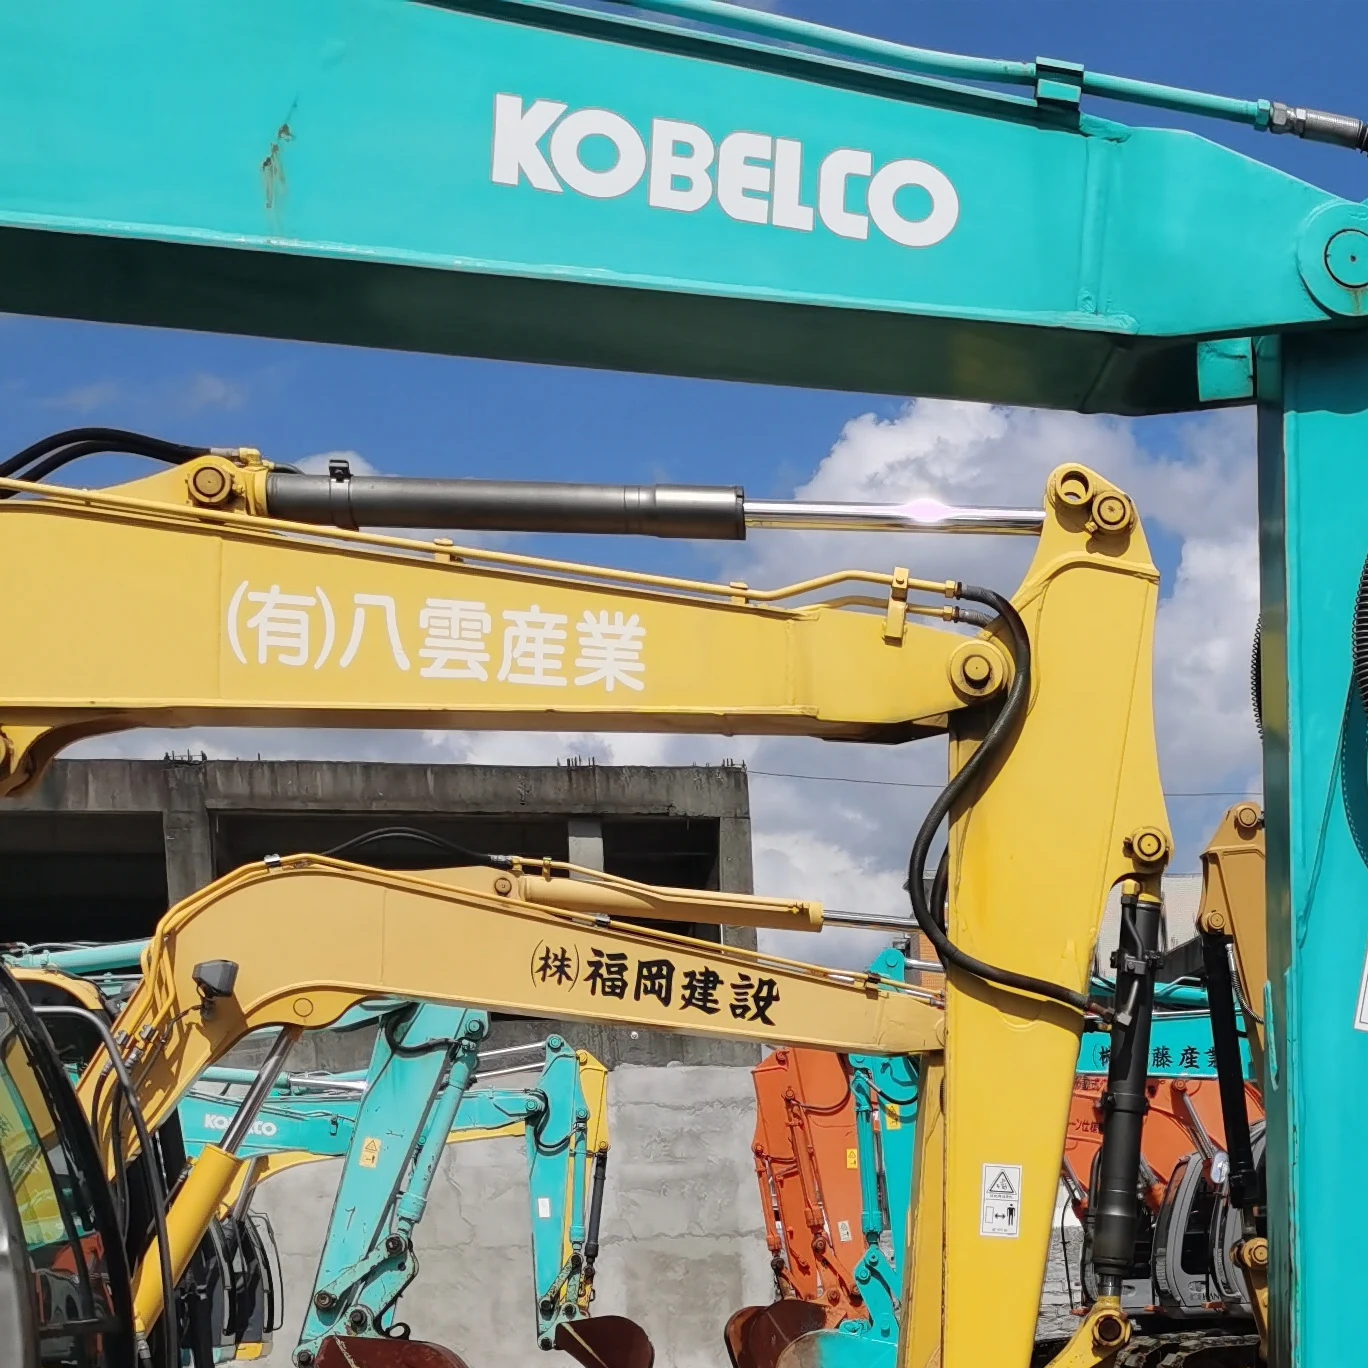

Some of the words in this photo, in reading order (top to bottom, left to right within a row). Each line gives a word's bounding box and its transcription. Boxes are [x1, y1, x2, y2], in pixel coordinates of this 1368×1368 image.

[490, 92, 960, 248] KOBELCO
[227, 579, 647, 692] (有)八雲産業
[530, 939, 782, 1027] (株)福岡建設
[204, 1113, 277, 1137] KOCO
